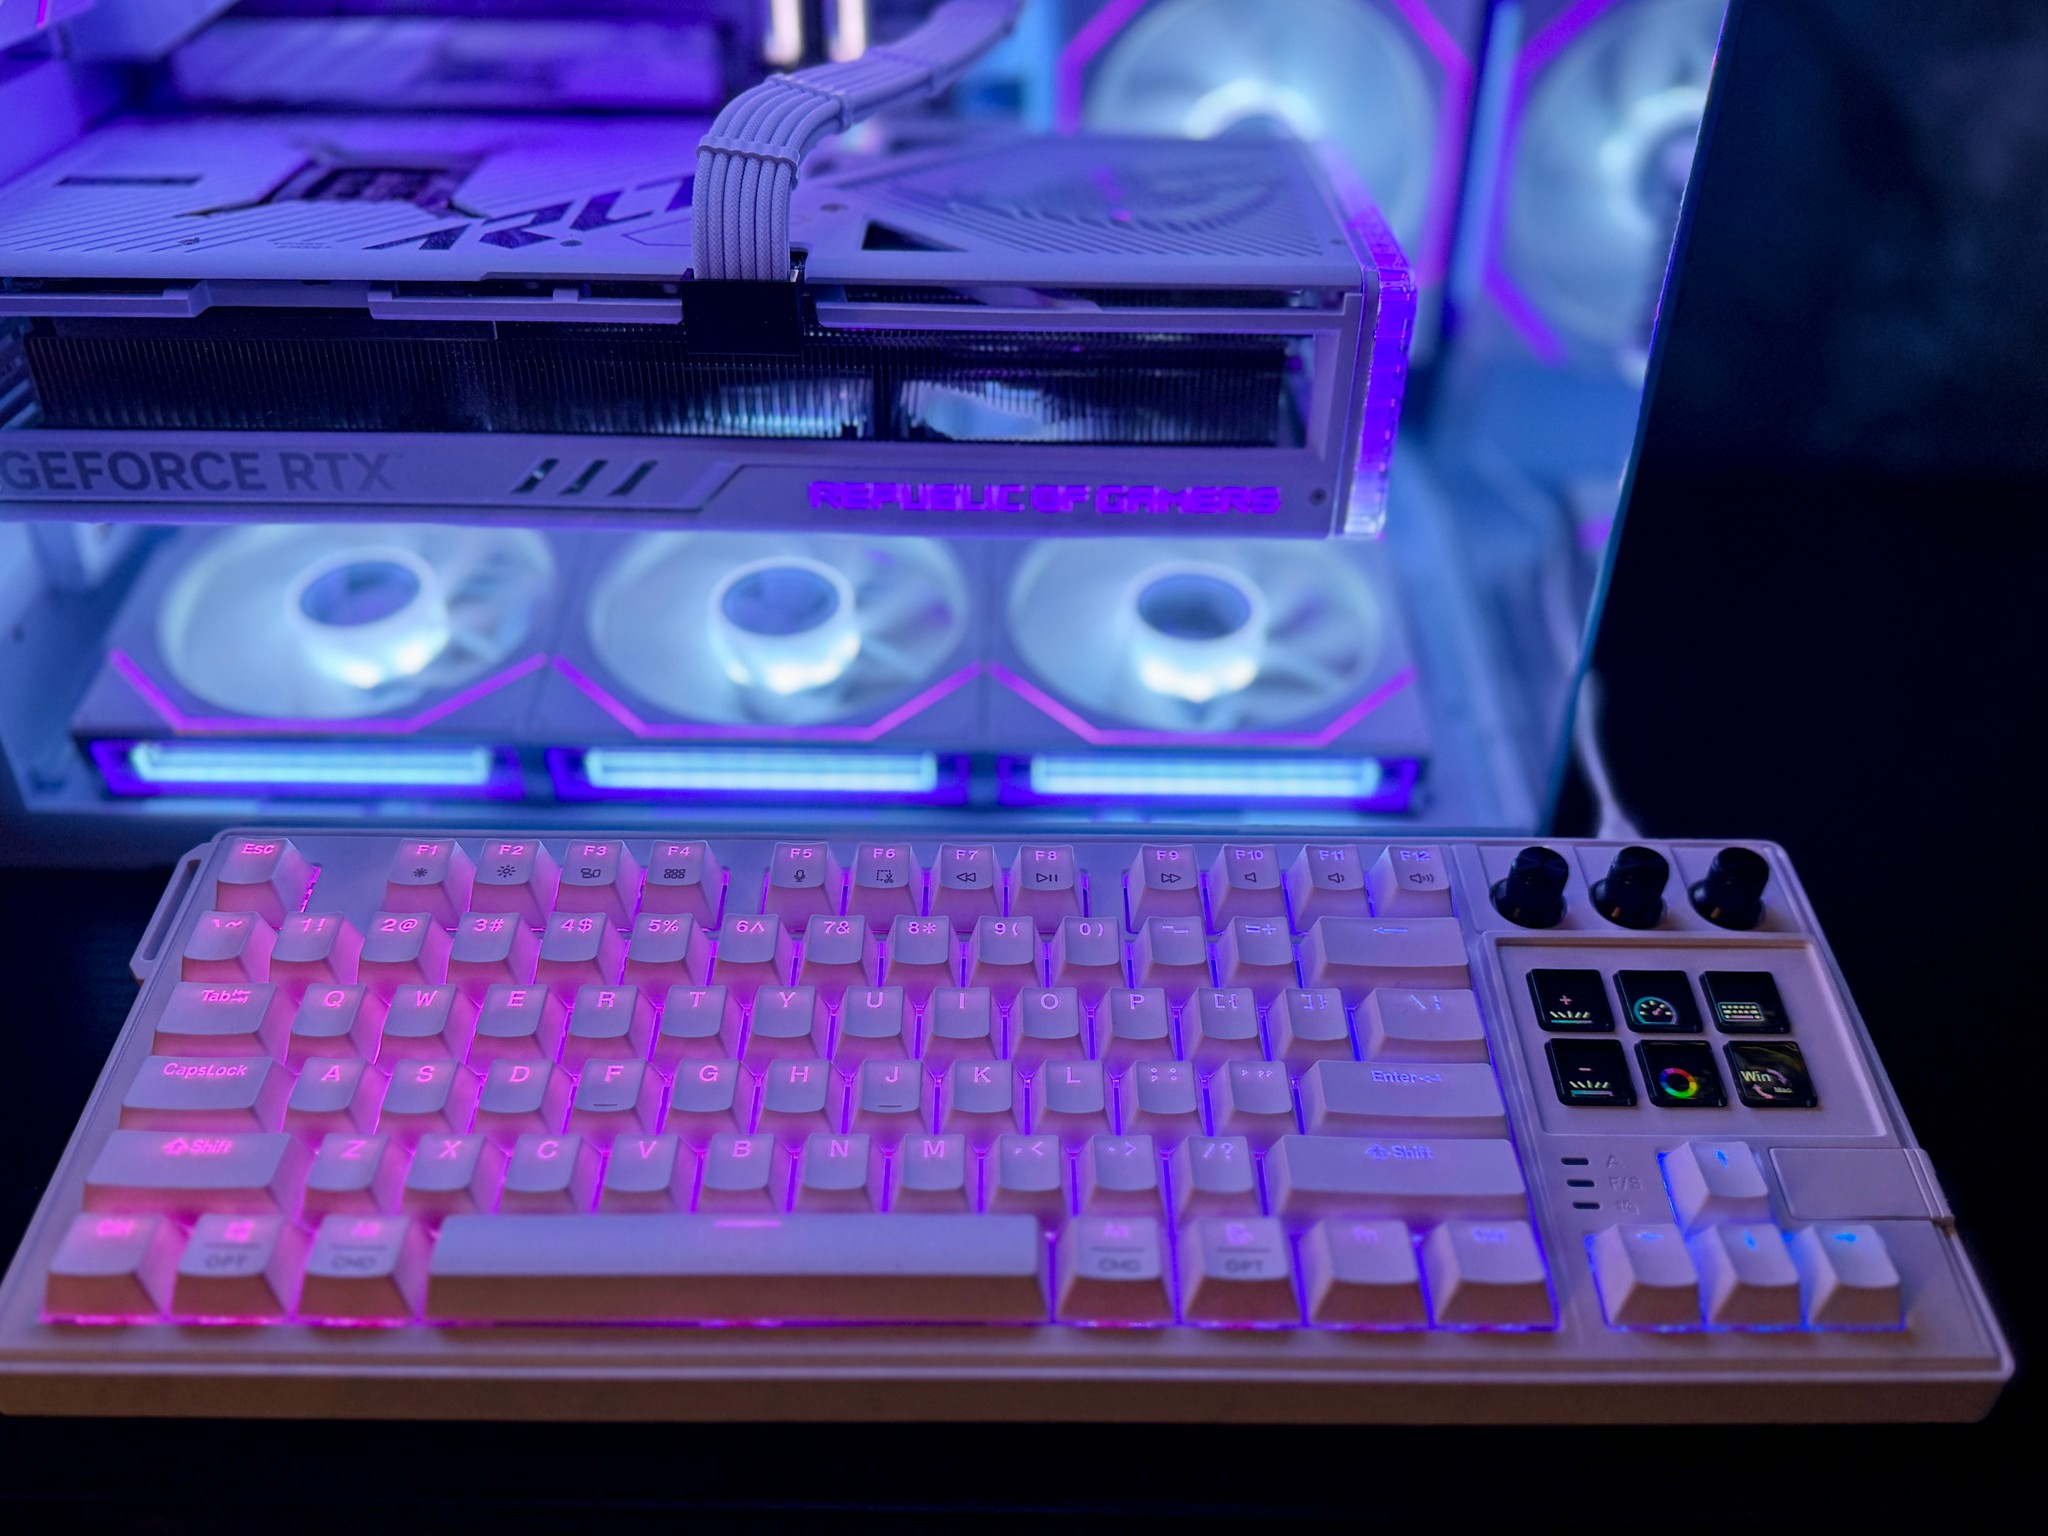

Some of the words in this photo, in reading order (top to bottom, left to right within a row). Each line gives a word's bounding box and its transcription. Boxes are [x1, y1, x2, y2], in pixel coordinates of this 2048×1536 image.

[0, 450, 266, 491] GEFORCE
[278, 452, 398, 492] RTX
[809, 481, 1025, 512] REPUBLIC
[1031, 485, 1091, 513] OF
[1096, 486, 1280, 514] GAMERS
[416, 845, 438, 855] F1
[499, 845, 524, 855] F2
[584, 845, 607, 855] F3
[668, 846, 690, 856] F4
[790, 848, 813, 858] F5
[873, 849, 895, 859] F6
[956, 850, 978, 860] F7
[1035, 851, 1057, 861] F8
[1157, 850, 1179, 860] F9
[1235, 850, 1264, 860] F10
[1319, 850, 1345, 860] F11
[1400, 850, 1430, 861] F12
[201, 990, 231, 1003] Tab
[323, 991, 345, 1007] Q
[415, 990, 437, 1007] W
[507, 991, 527, 1007] E
[597, 992, 616, 1007] R
[690, 992, 706, 1007] T
[779, 991, 796, 1008] Y
[866, 992, 883, 1008] U
[1040, 993, 1059, 1009] O
[1130, 994, 1145, 1009] P
[163, 1062, 248, 1080] CapsLock
[321, 1065, 341, 1081] A
[415, 1065, 435, 1083] S
[510, 1066, 531, 1083] D
[604, 1065, 623, 1082] F
[699, 1065, 718, 1082] G
[790, 1066, 809, 1083] H
[885, 1066, 899, 1083] J
[974, 1067, 991, 1083] K
[1066, 1067, 1080, 1084] L
[1371, 1070, 1419, 1083] Enter
[1740, 1071, 1771, 1081] Win
[190, 1139, 234, 1154] Shift
[341, 1140, 366, 1158] Z
[439, 1140, 462, 1158] X
[537, 1140, 559, 1159] C
[638, 1141, 657, 1159] V
[732, 1141, 751, 1157] B
[829, 1140, 849, 1158] N
[923, 1140, 945, 1158] M
[1392, 1144, 1434, 1160] Shift
